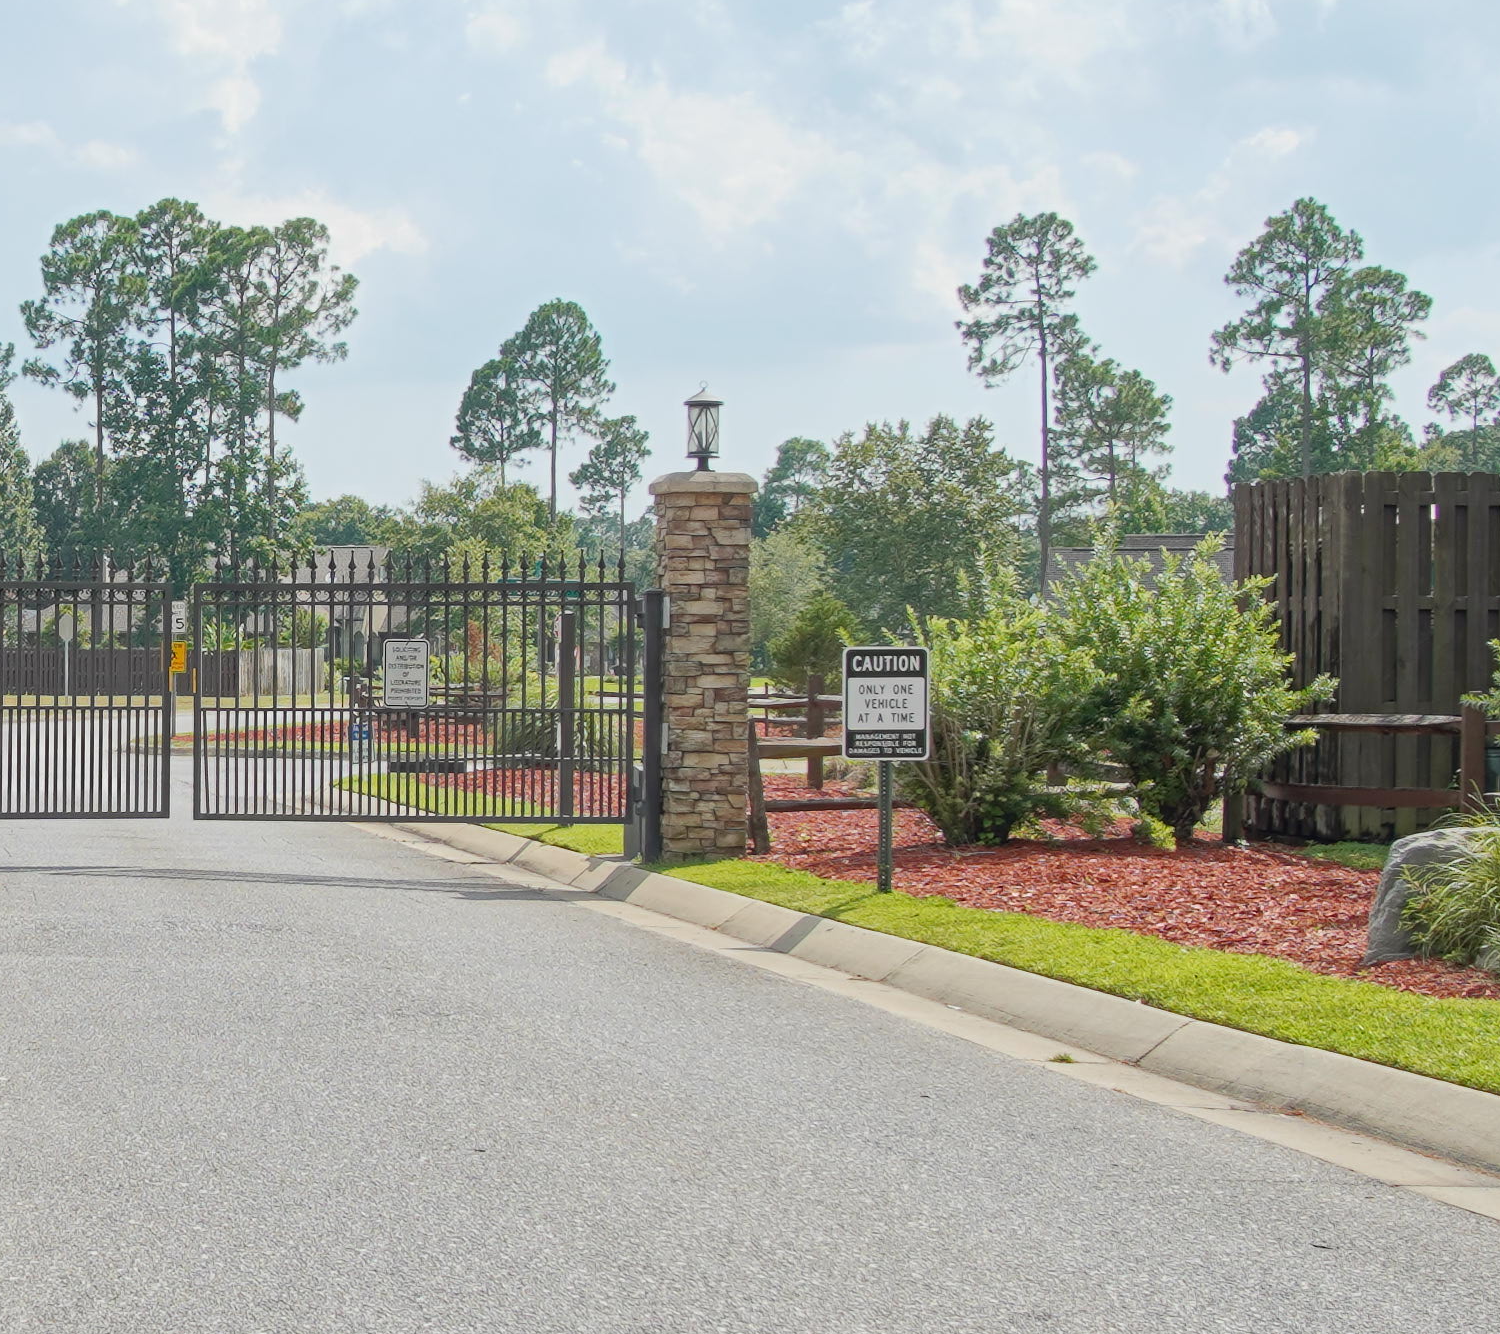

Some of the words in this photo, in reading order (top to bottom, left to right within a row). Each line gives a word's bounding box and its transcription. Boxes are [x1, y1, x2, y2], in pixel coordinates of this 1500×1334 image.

[853, 656, 920, 671] CAUTION
[858, 684, 886, 695] ONLY
[893, 684, 914, 695] ONE
[864, 698, 909, 709] VEHICLE
[858, 713, 870, 723] AT
[877, 713, 884, 723] A
[891, 713, 915, 723] TIME
